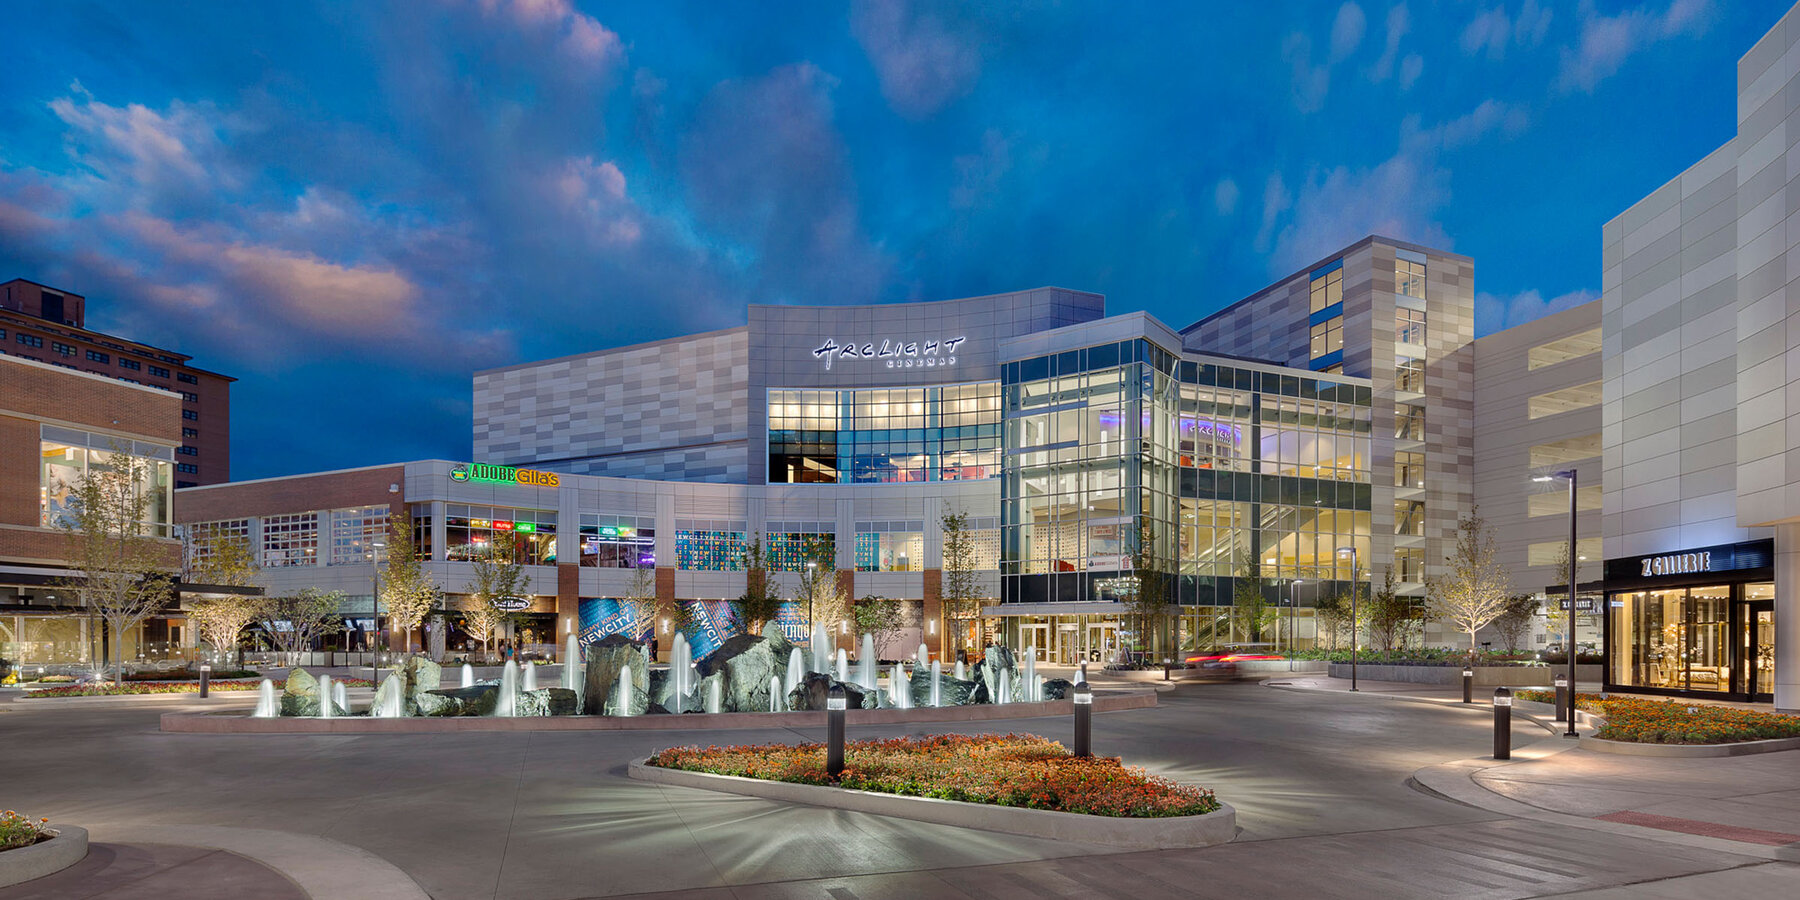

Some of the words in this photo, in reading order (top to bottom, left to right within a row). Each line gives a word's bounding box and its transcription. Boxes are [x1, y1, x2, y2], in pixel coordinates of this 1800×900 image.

[812, 336, 967, 371] ARCLIGHT
[886, 356, 957, 368] CINEMAS
[471, 464, 516, 482] ADOBE
[1641, 558, 1653, 577] Z
[1652, 551, 1711, 576] GALLERIE
[579, 613, 631, 648] NEWCITY
[691, 602, 723, 648] NEWCIT
